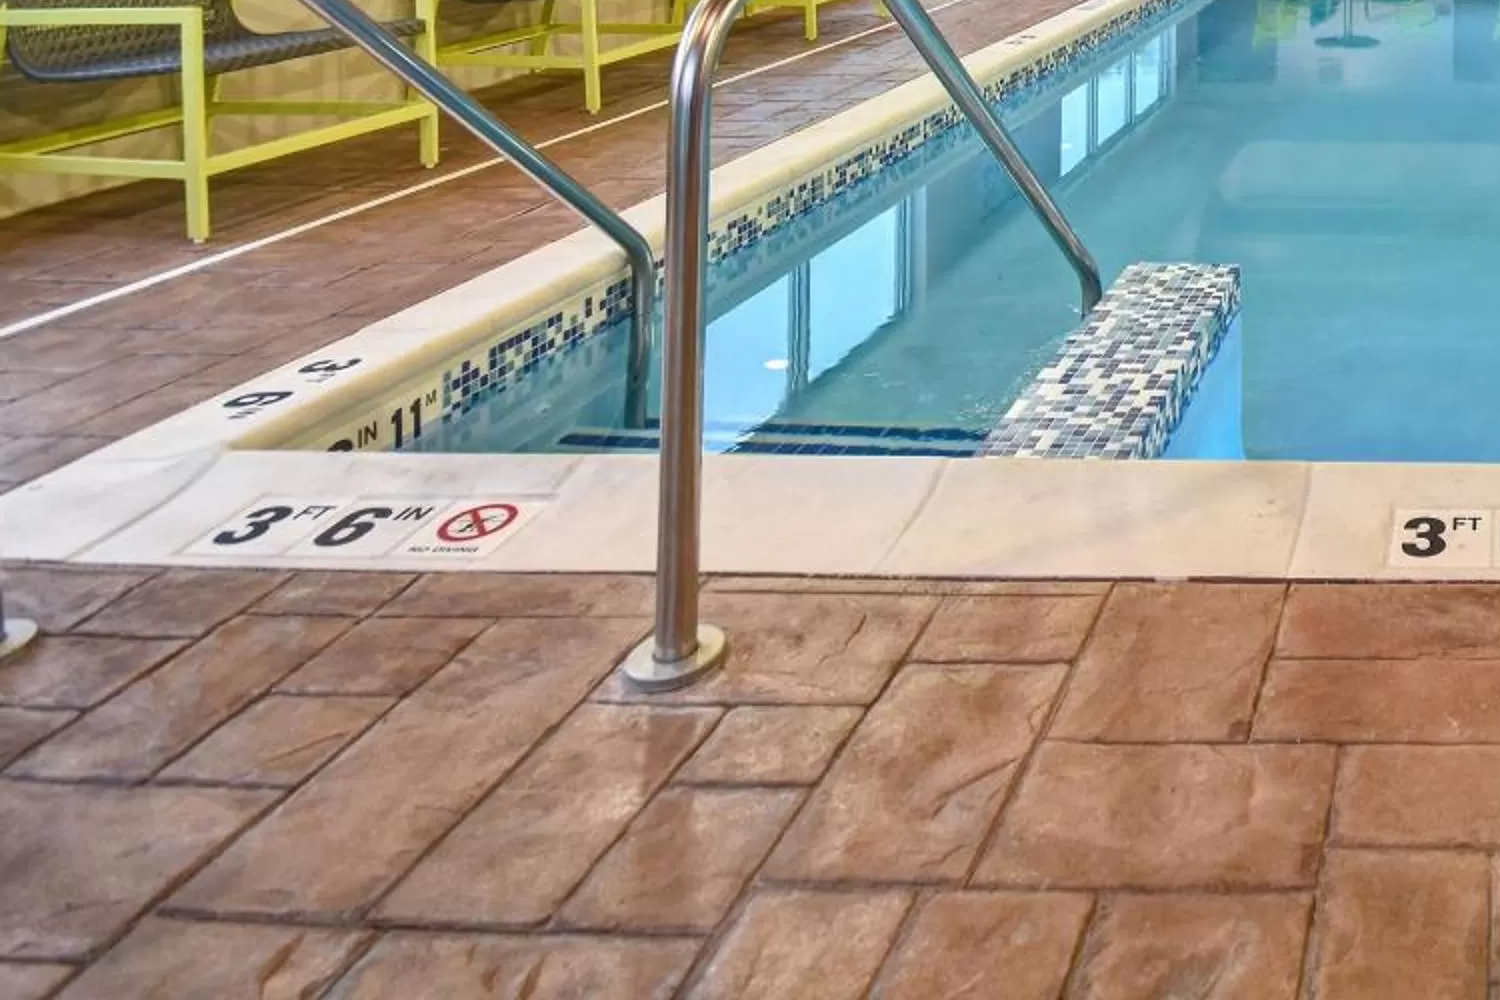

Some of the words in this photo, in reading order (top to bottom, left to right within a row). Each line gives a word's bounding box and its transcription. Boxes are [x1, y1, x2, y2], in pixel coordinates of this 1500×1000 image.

[357, 420, 377, 449] IN
[425, 388, 437, 407] M
[212, 505, 293, 545] 3
[293, 505, 337, 521] FT
[313, 507, 393, 547] 6
[393, 505, 434, 521] IN
[1401, 516, 1446, 558] 3
[1452, 517, 1482, 531] FT
